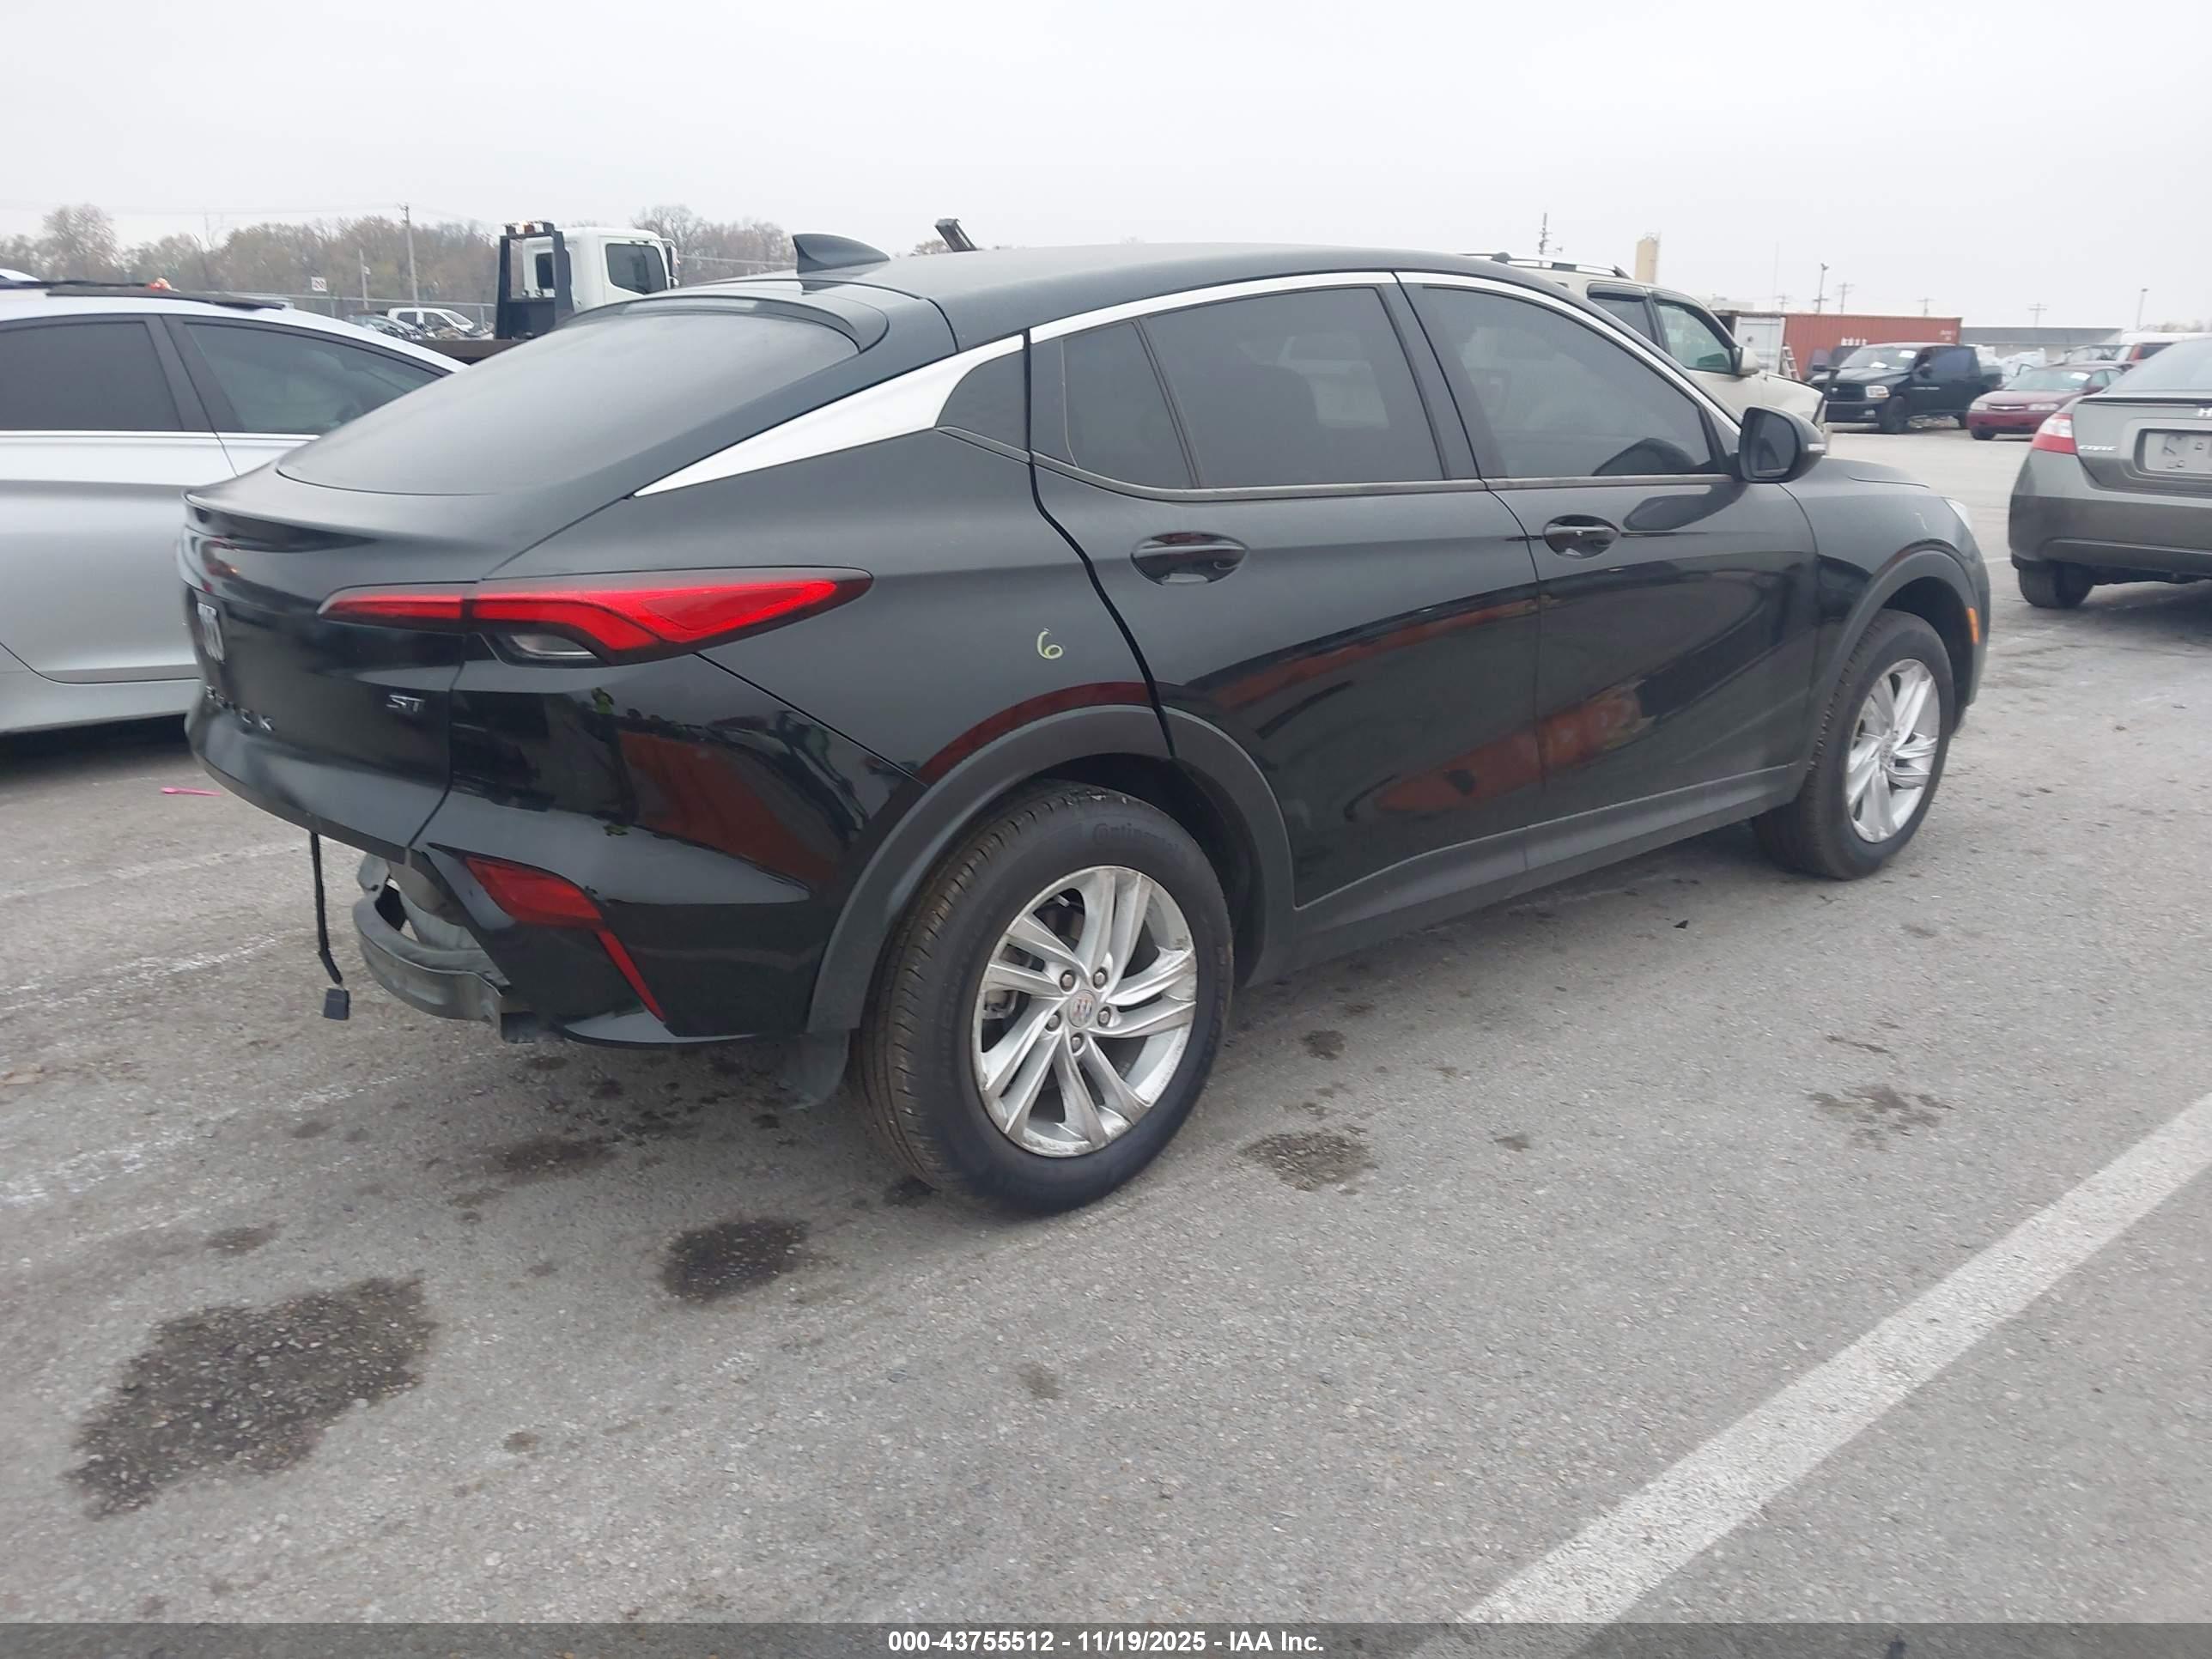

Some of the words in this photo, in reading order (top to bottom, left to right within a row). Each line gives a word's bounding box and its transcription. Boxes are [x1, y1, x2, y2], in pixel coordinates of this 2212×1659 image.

[1036, 628, 1065, 660] 6
[386, 694, 426, 714] ST
[1092, 822, 1182, 853] Contin
